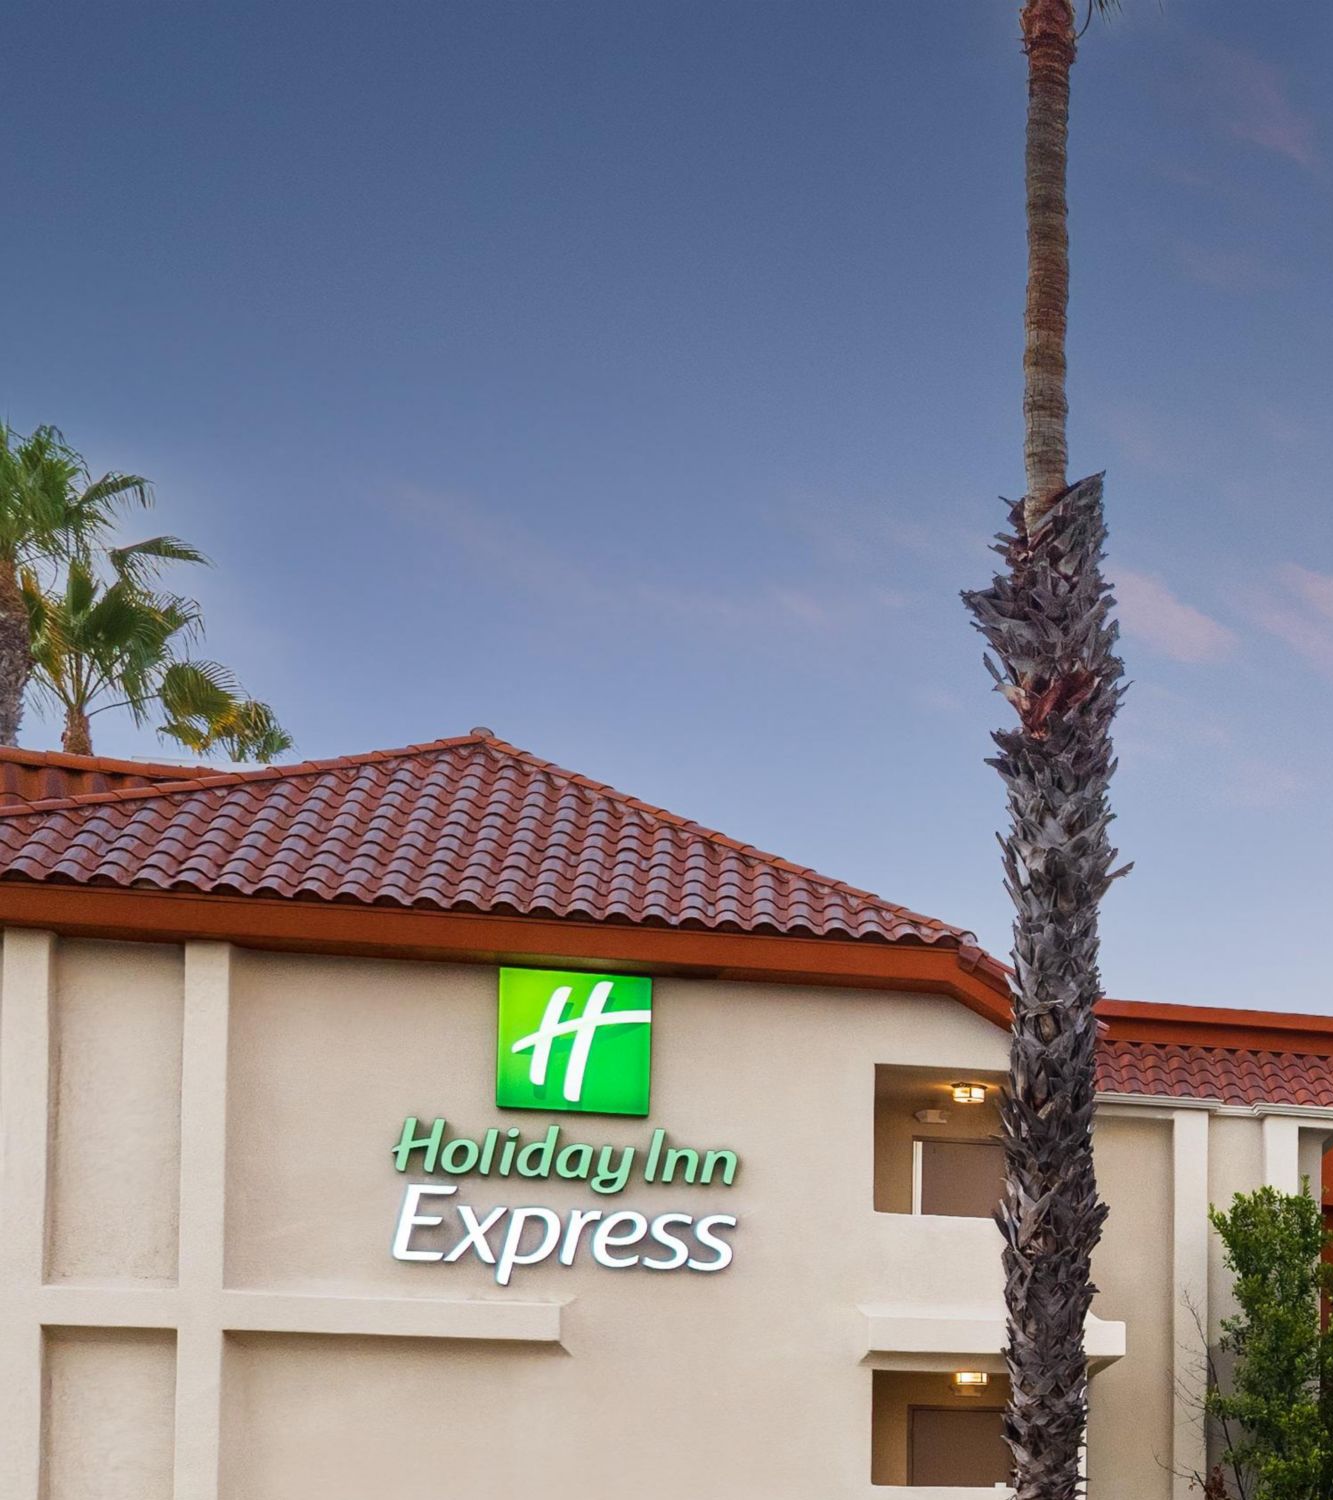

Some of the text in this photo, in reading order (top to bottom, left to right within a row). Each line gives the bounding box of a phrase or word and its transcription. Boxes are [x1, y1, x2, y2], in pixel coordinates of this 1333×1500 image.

[391, 1116, 739, 1194] Holiday Inn
[391, 1183, 737, 1286] Express
